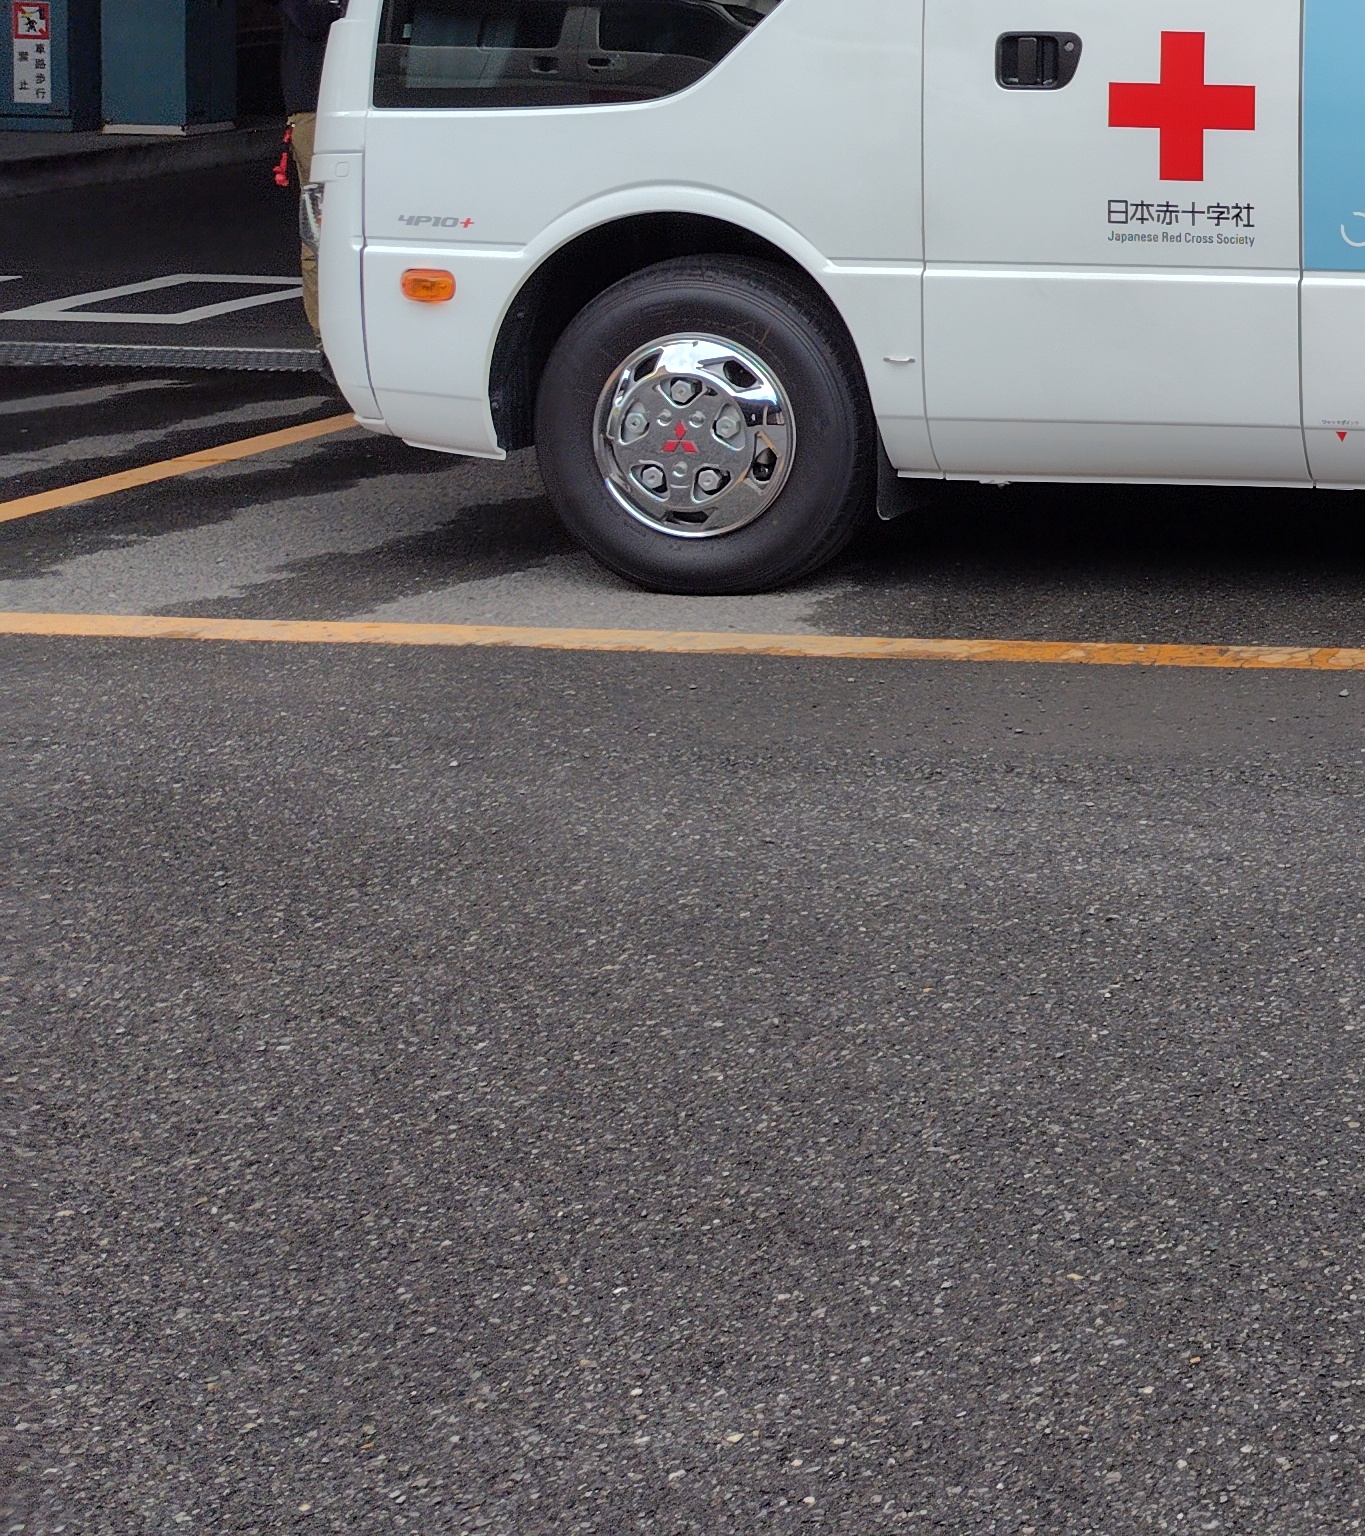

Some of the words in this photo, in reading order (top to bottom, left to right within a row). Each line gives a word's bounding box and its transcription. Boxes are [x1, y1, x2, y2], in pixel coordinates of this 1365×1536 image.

[1107, 199, 1255, 227] 日本赤十字社
[1108, 231, 1159, 243] Japanese
[1162, 232, 1182, 243] Red
[1185, 233, 1214, 244] Cross
[1217, 233, 1255, 247] Society
